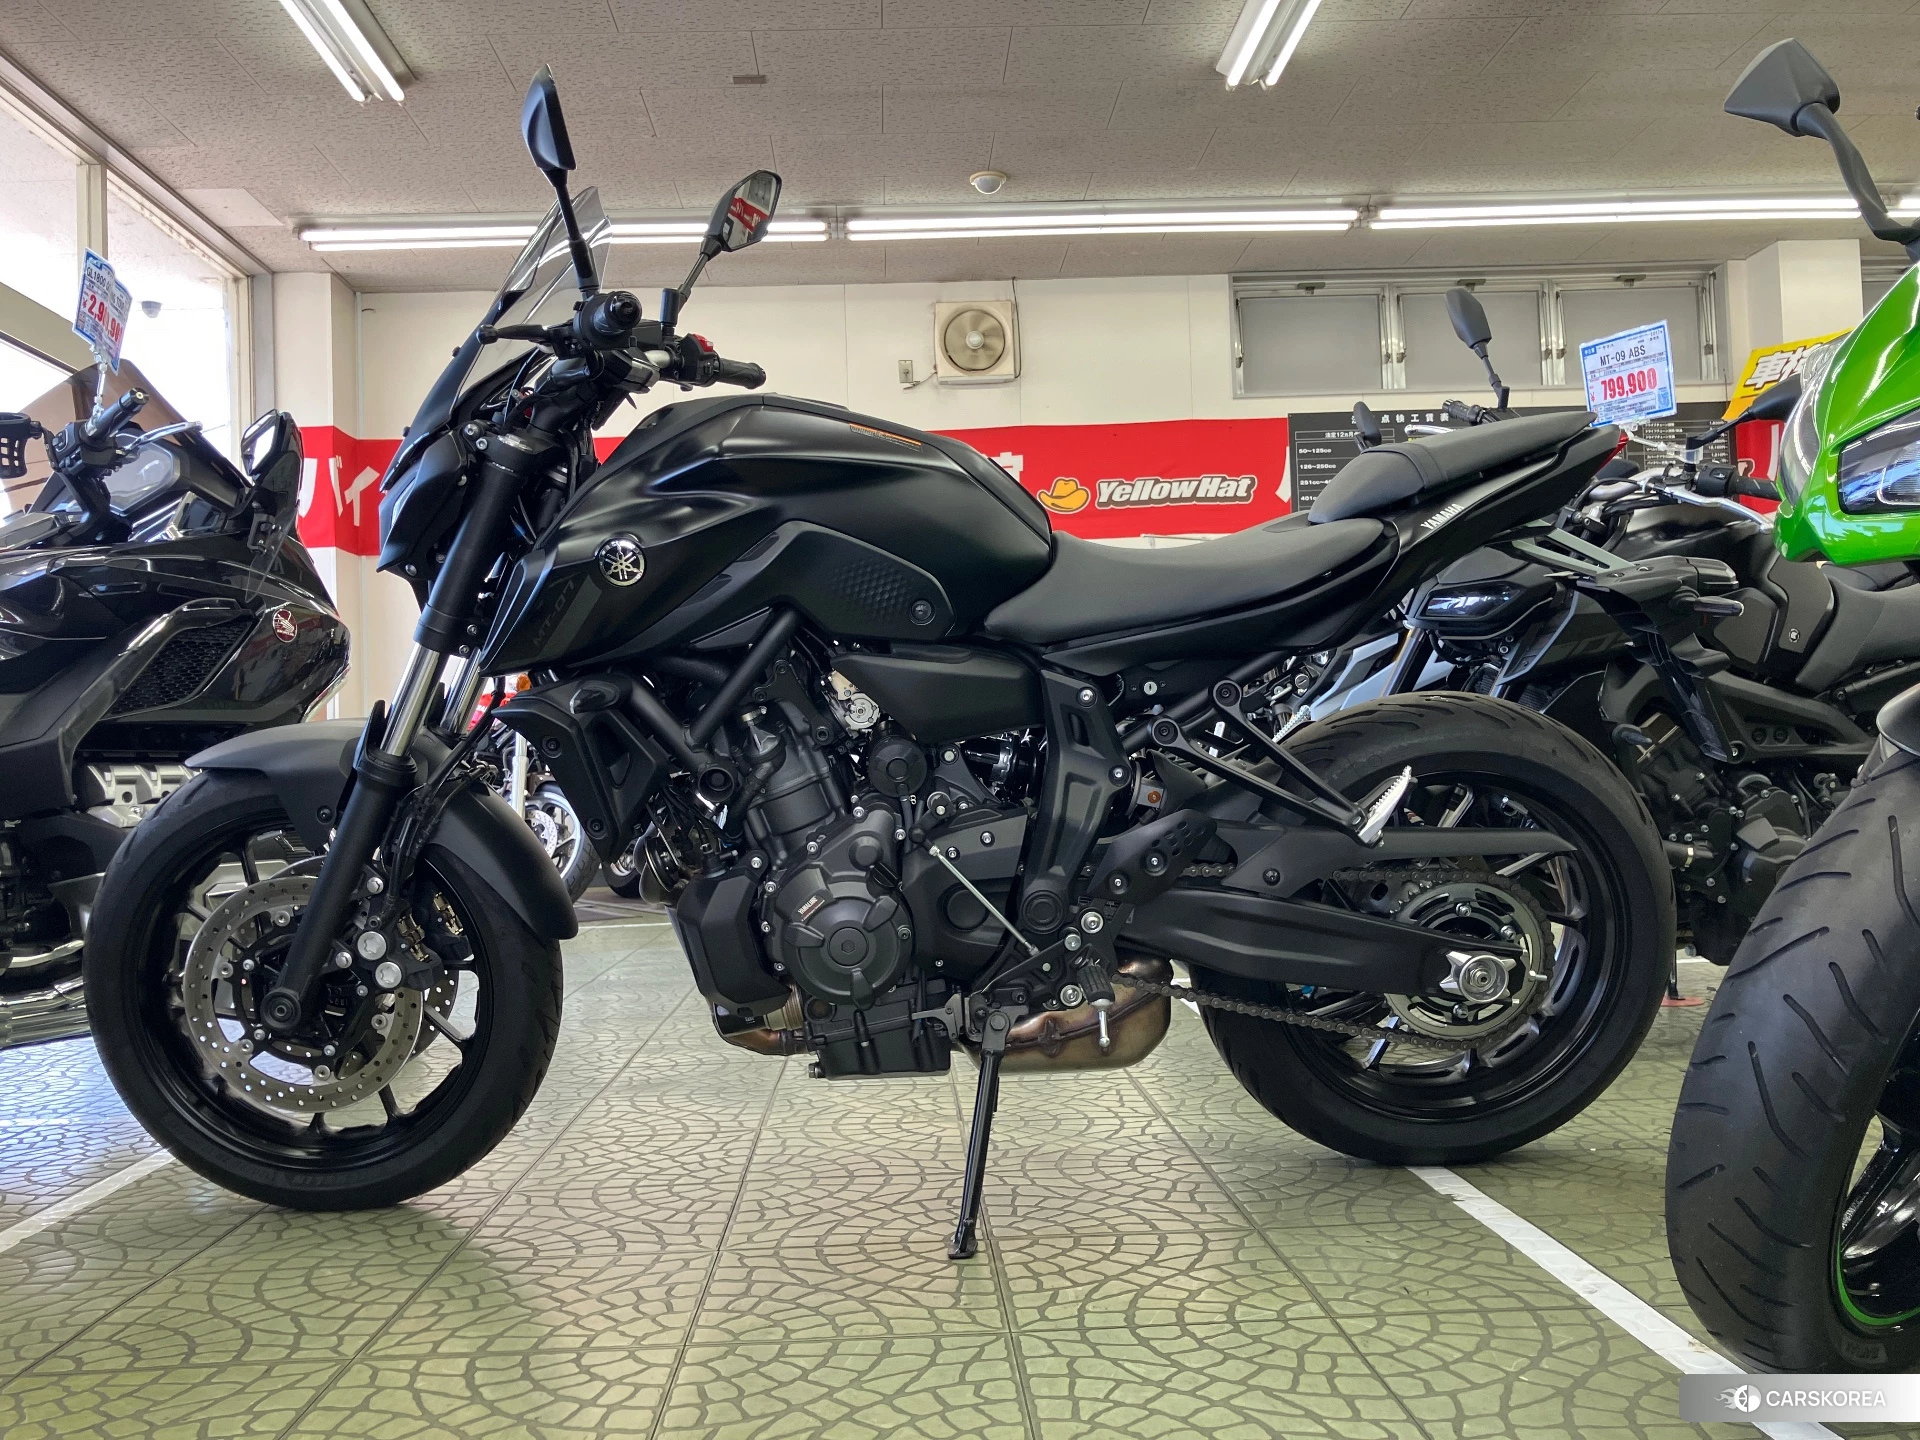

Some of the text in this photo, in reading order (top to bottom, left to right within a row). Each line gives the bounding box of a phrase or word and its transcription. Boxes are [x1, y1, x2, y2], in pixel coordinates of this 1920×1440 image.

[1600, 350, 1626, 366] MT-09
[1629, 345, 1646, 359] ABS
[1601, 368, 1657, 401] 799,900
[1420, 503, 1465, 530] YAMAHA
